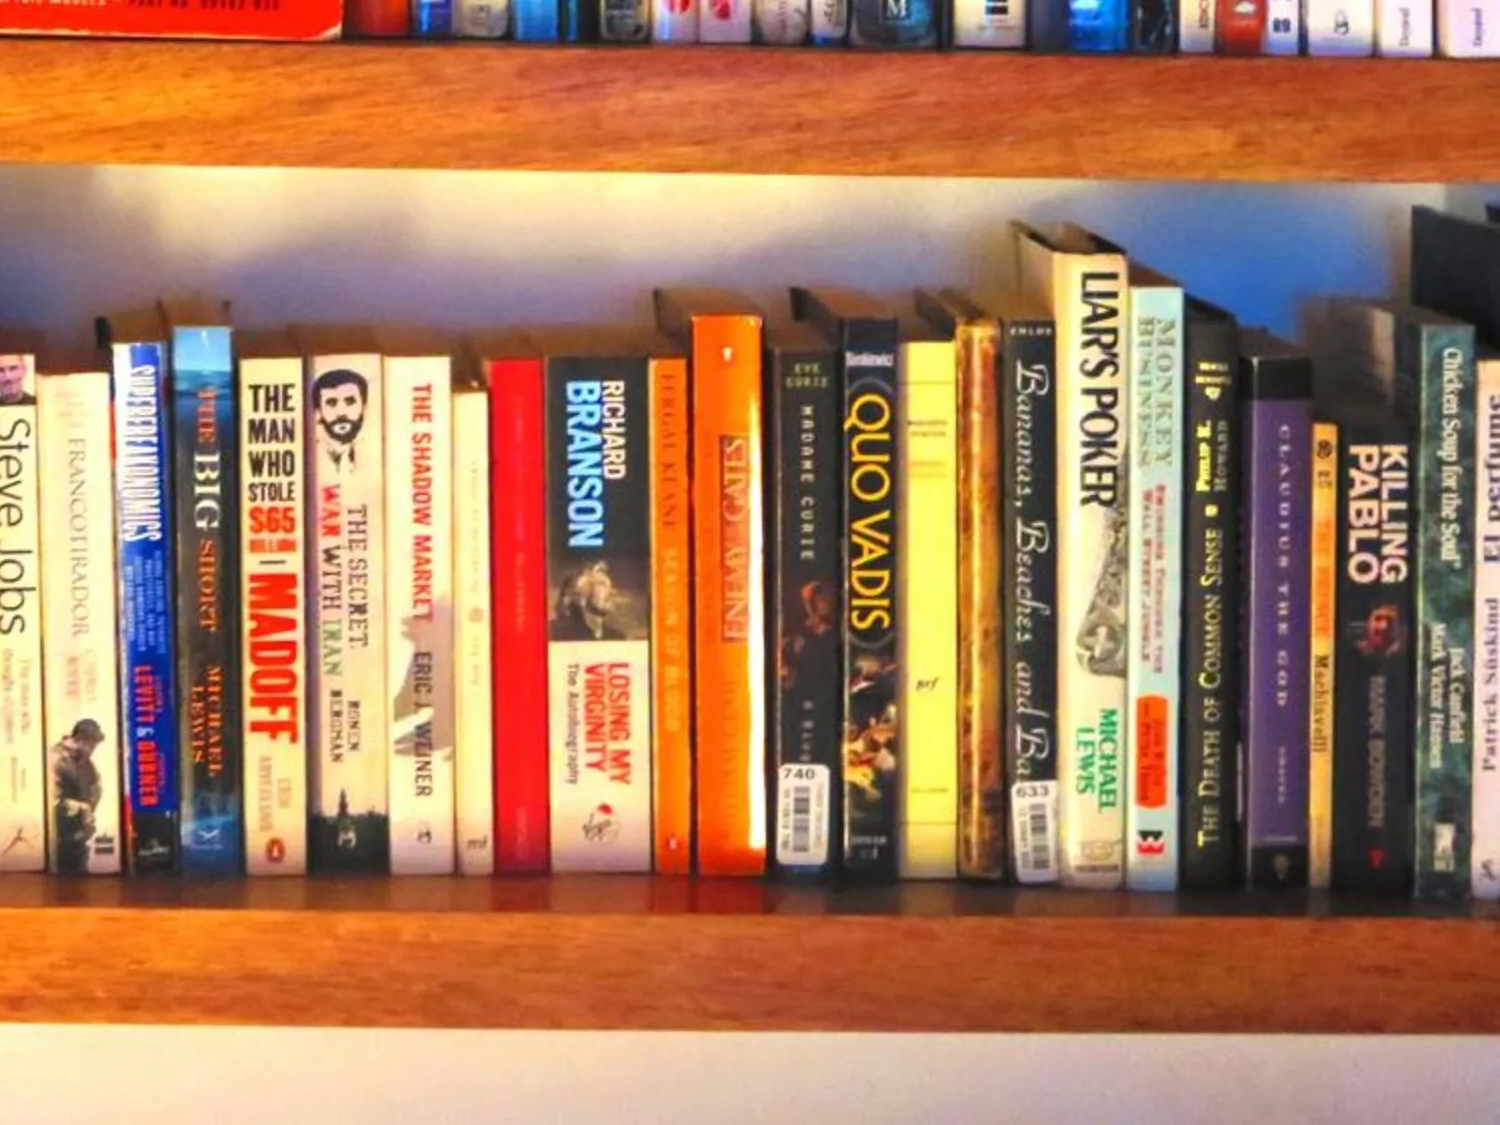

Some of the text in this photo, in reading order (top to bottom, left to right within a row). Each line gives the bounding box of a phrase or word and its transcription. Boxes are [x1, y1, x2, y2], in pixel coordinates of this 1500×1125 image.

[247, 384, 297, 412] THE
[247, 418, 296, 445] MAN
[412, 383, 434, 424] THE
[603, 380, 627, 481] RICHARD
[1012, 359, 1051, 509] Bananas,
[1079, 271, 1120, 509] LIAR'S POKER
[1136, 315, 1154, 470] BUSINESS
[1153, 316, 1177, 469] MONKEY
[123, 365, 163, 543] SUPERFREAKONOMICS
[193, 389, 222, 633] THE BIG SHORT
[248, 451, 296, 477] WHO
[248, 482, 296, 503] STOLE
[412, 432, 434, 525] SHADOW
[566, 381, 605, 548] BRANSON
[801, 405, 814, 561] MADAME CURIE
[843, 393, 892, 631] QUO VADIS
[1347, 444, 1380, 585] PABLO
[1378, 444, 1409, 585] KILLING
[321, 484, 344, 676] WAR WITH IRAN
[346, 504, 369, 648] THE SECRET
[411, 534, 433, 623] MARKET
[1013, 519, 1051, 643] Beaches
[1276, 424, 1291, 708] CLAUDIUS THE GOD
[249, 572, 300, 744] MADOFF
[413, 650, 433, 694] ERIC
[584, 663, 608, 774] VIRGINITY
[1014, 661, 1050, 715] and
[1198, 530, 1224, 847] THE DEATH OF COMMON SENSE
[191, 684, 206, 764] LEWIS
[207, 664, 223, 777] MICHAEL
[413, 721, 434, 797] WEINER
[609, 662, 632, 786] LOSING MY
[1076, 727, 1096, 796] LEWIS
[1097, 708, 1118, 815] MICHAEL
